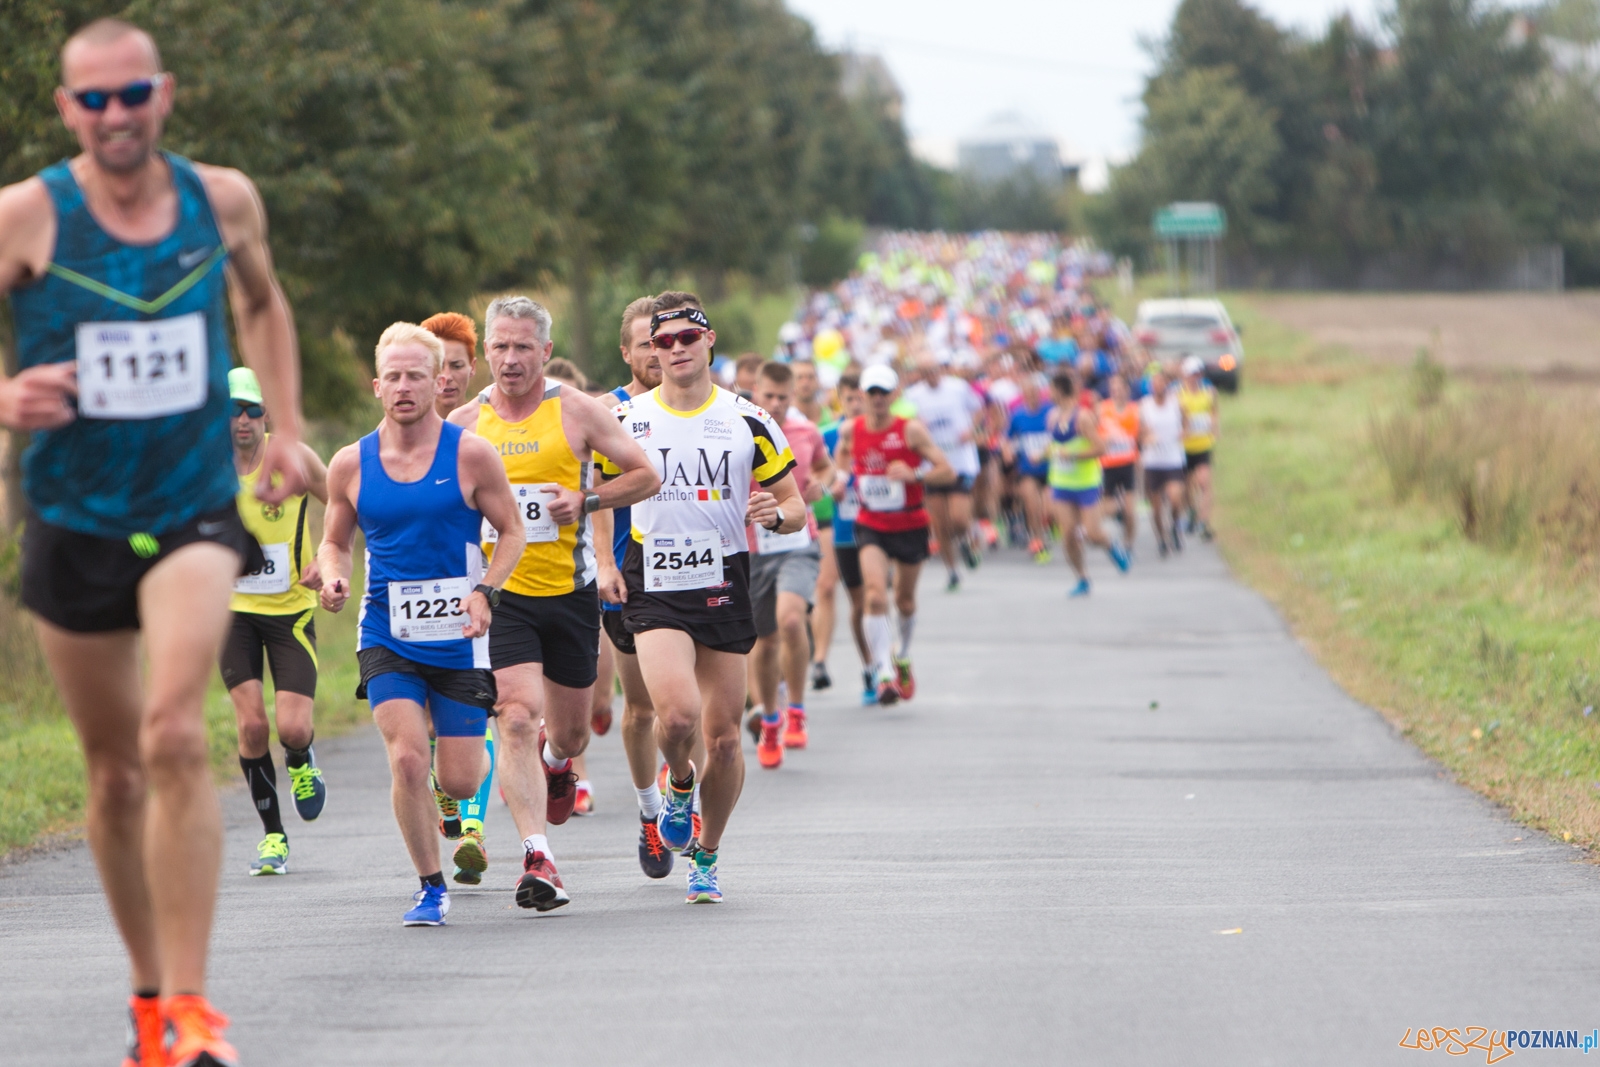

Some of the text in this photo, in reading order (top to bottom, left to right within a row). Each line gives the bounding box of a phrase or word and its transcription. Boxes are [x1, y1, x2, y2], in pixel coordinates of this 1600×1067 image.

[98, 347, 188, 381] 1121
[632, 421, 650, 433] BCM
[704, 418, 724, 427] OSSM
[653, 548, 714, 570] 2544
[400, 597, 464, 620] 1223
